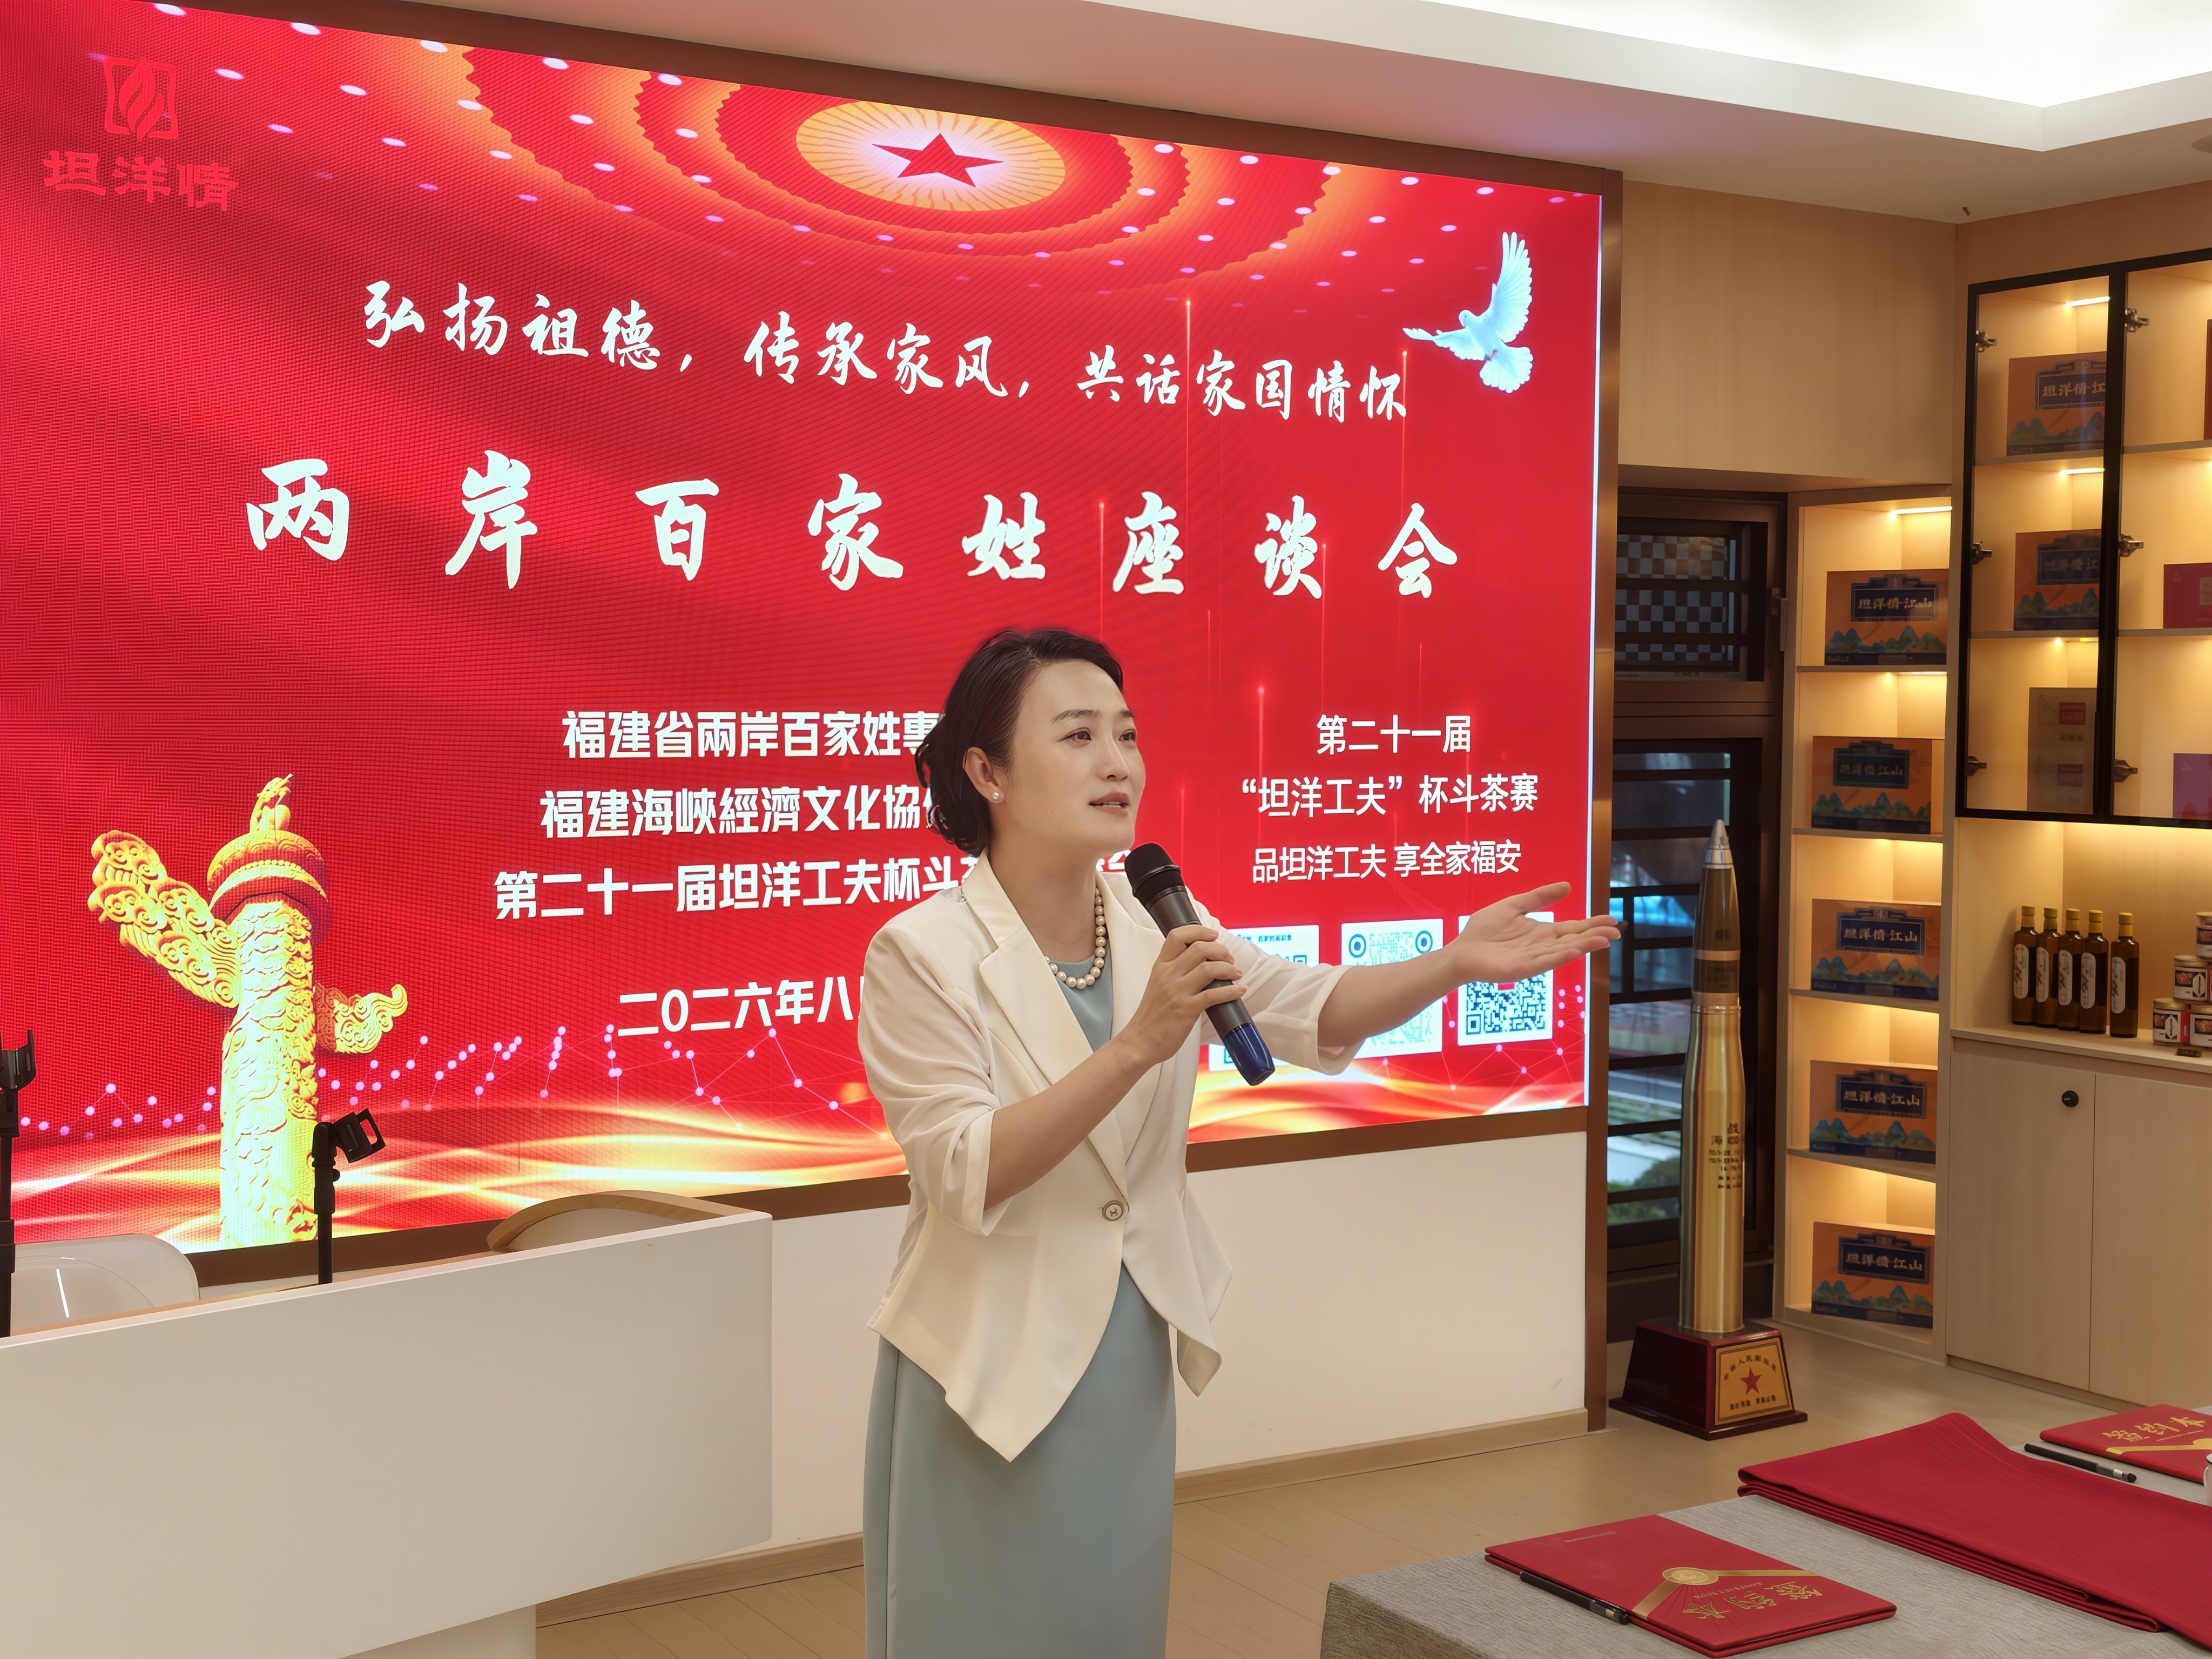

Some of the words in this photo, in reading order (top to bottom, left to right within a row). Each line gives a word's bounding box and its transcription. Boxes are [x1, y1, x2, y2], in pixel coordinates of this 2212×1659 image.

[43, 149, 239, 212] 坦洋情
[246, 450, 1458, 599] 两岸百家姓座谈会
[1316, 714, 1471, 755] 第二十一届
[540, 784, 932, 838] 福建海峽經濟文化協
[1252, 844, 1386, 883] 品坦洋工夫
[1393, 839, 1521, 878] 享全家福安
